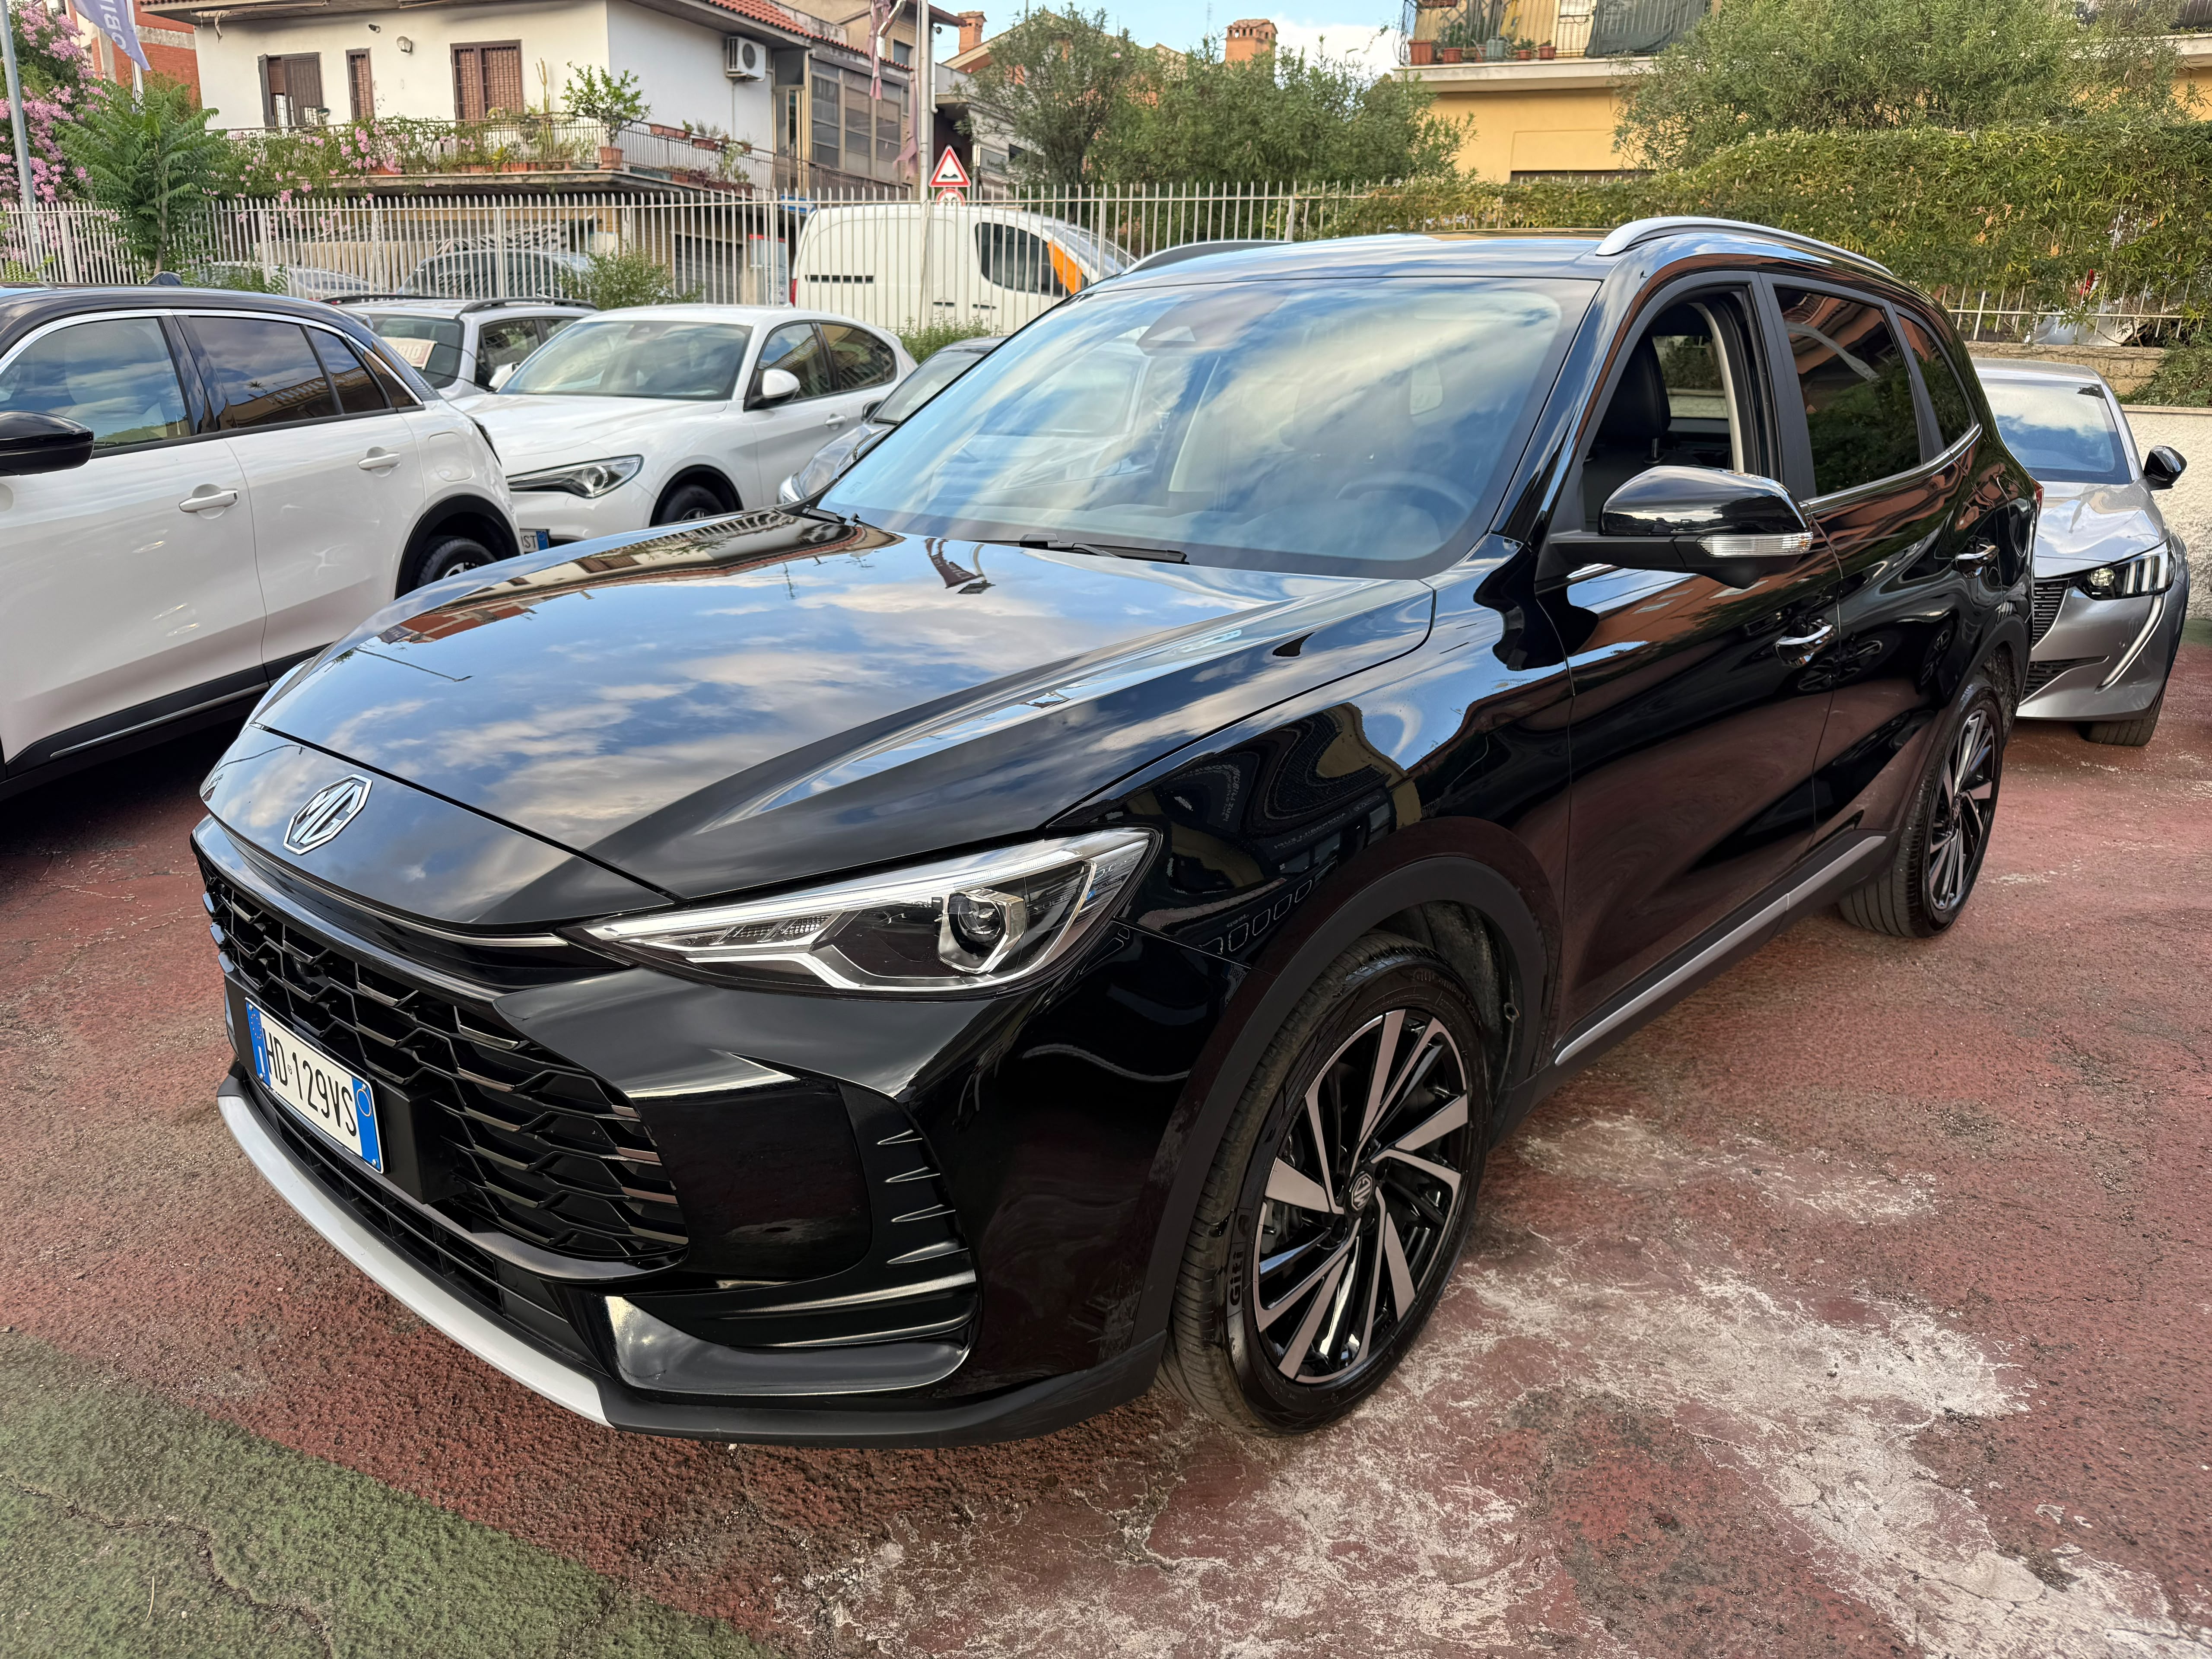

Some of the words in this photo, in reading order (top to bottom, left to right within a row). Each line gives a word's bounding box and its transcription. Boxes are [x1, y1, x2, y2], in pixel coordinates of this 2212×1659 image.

[292, 782, 363, 845] MG
[262, 1027, 288, 1086] HD
[292, 1052, 357, 1137] 129VS
[1230, 1251, 1244, 1306] Giti
